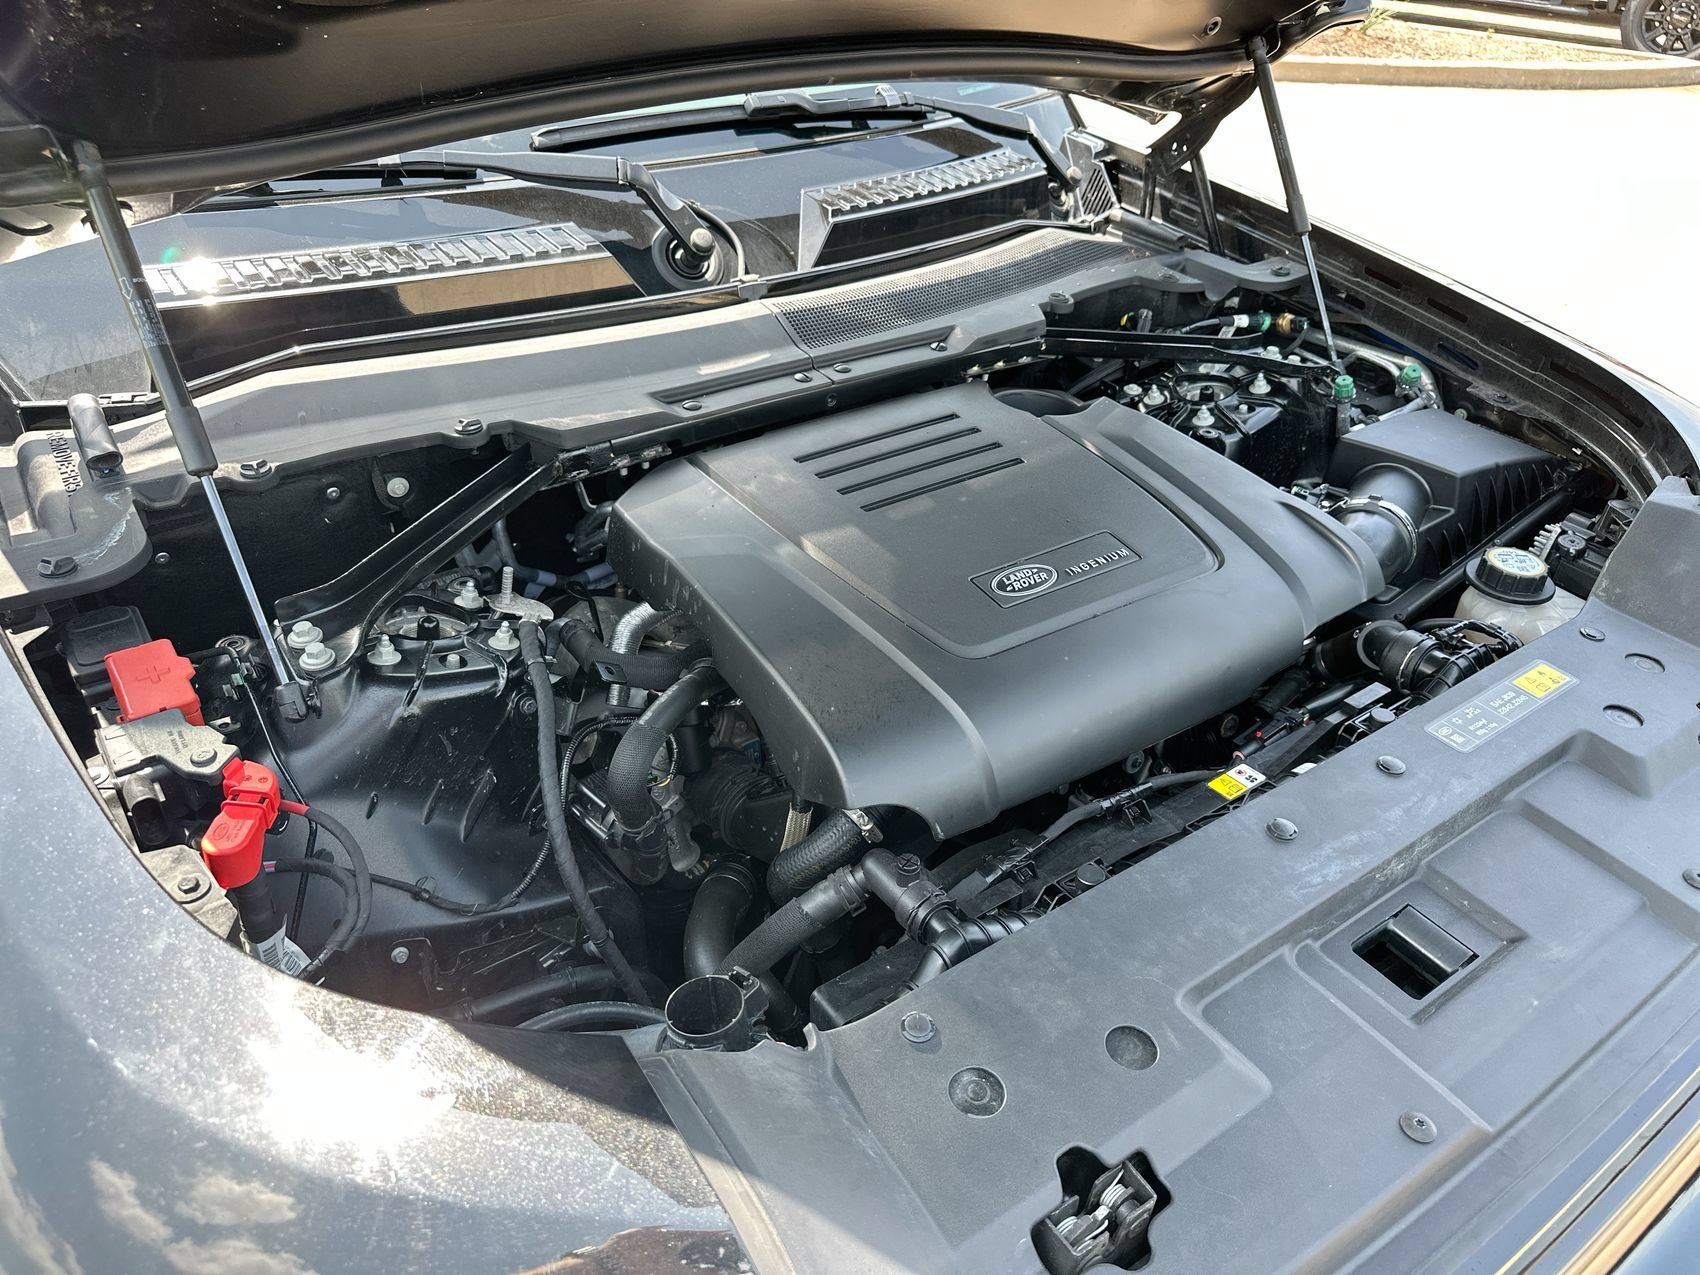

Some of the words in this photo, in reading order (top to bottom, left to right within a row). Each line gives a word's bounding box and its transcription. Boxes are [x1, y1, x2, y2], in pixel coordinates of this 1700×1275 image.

[46, 431, 76, 471] REMOVE
[60, 468, 83, 498] FIRS
[1065, 548, 1130, 576] INGENIUM
[1002, 568, 1033, 585] LAND
[1011, 572, 1049, 591] ROVER
